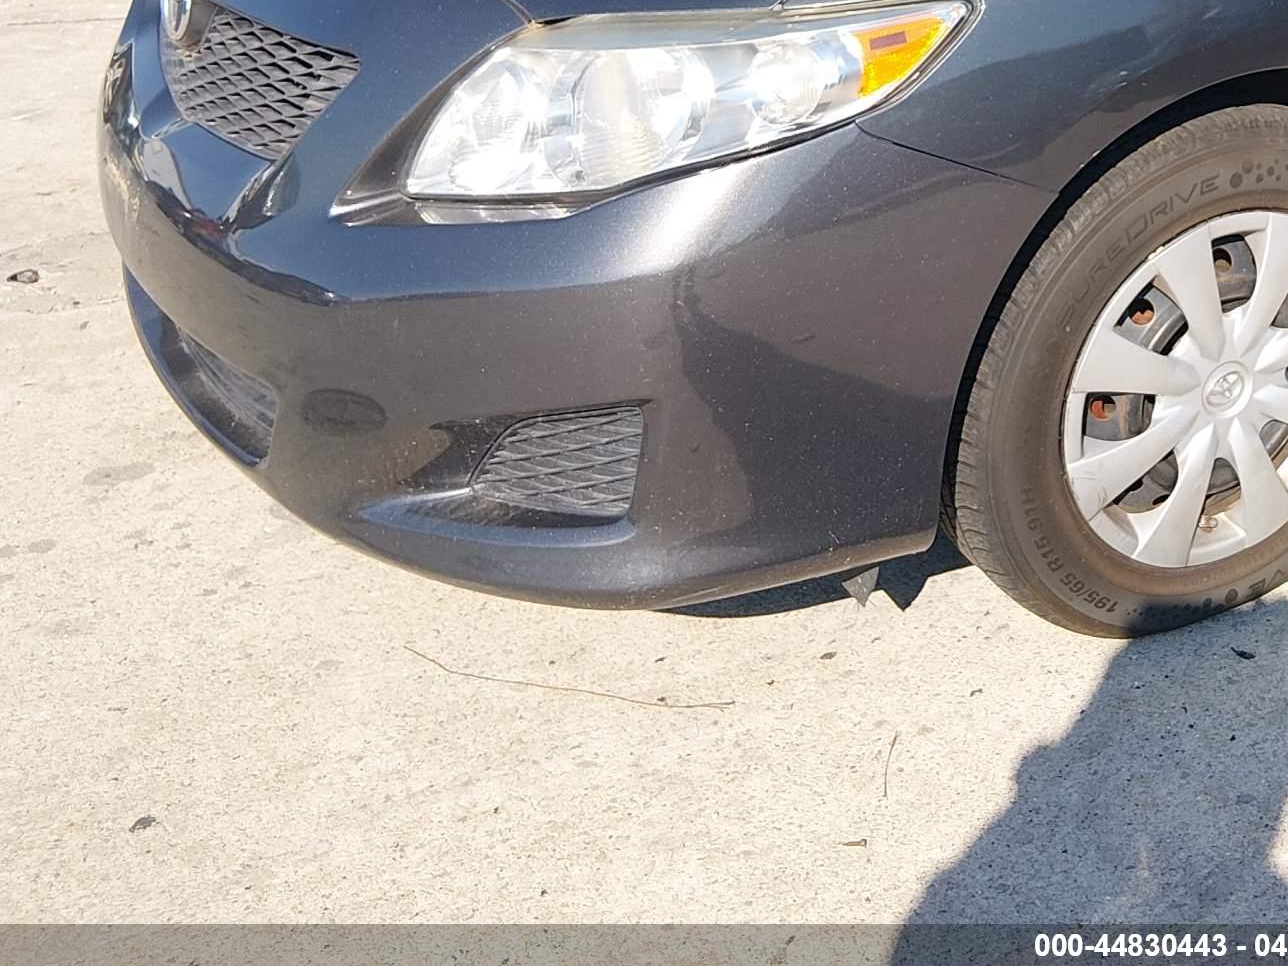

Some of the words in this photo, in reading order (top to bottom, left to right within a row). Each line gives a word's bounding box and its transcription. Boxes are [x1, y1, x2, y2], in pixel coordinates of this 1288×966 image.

[1019, 487, 1042, 532] 91H
[1033, 535, 1065, 572] R15
[1059, 572, 1119, 615] 195/65
